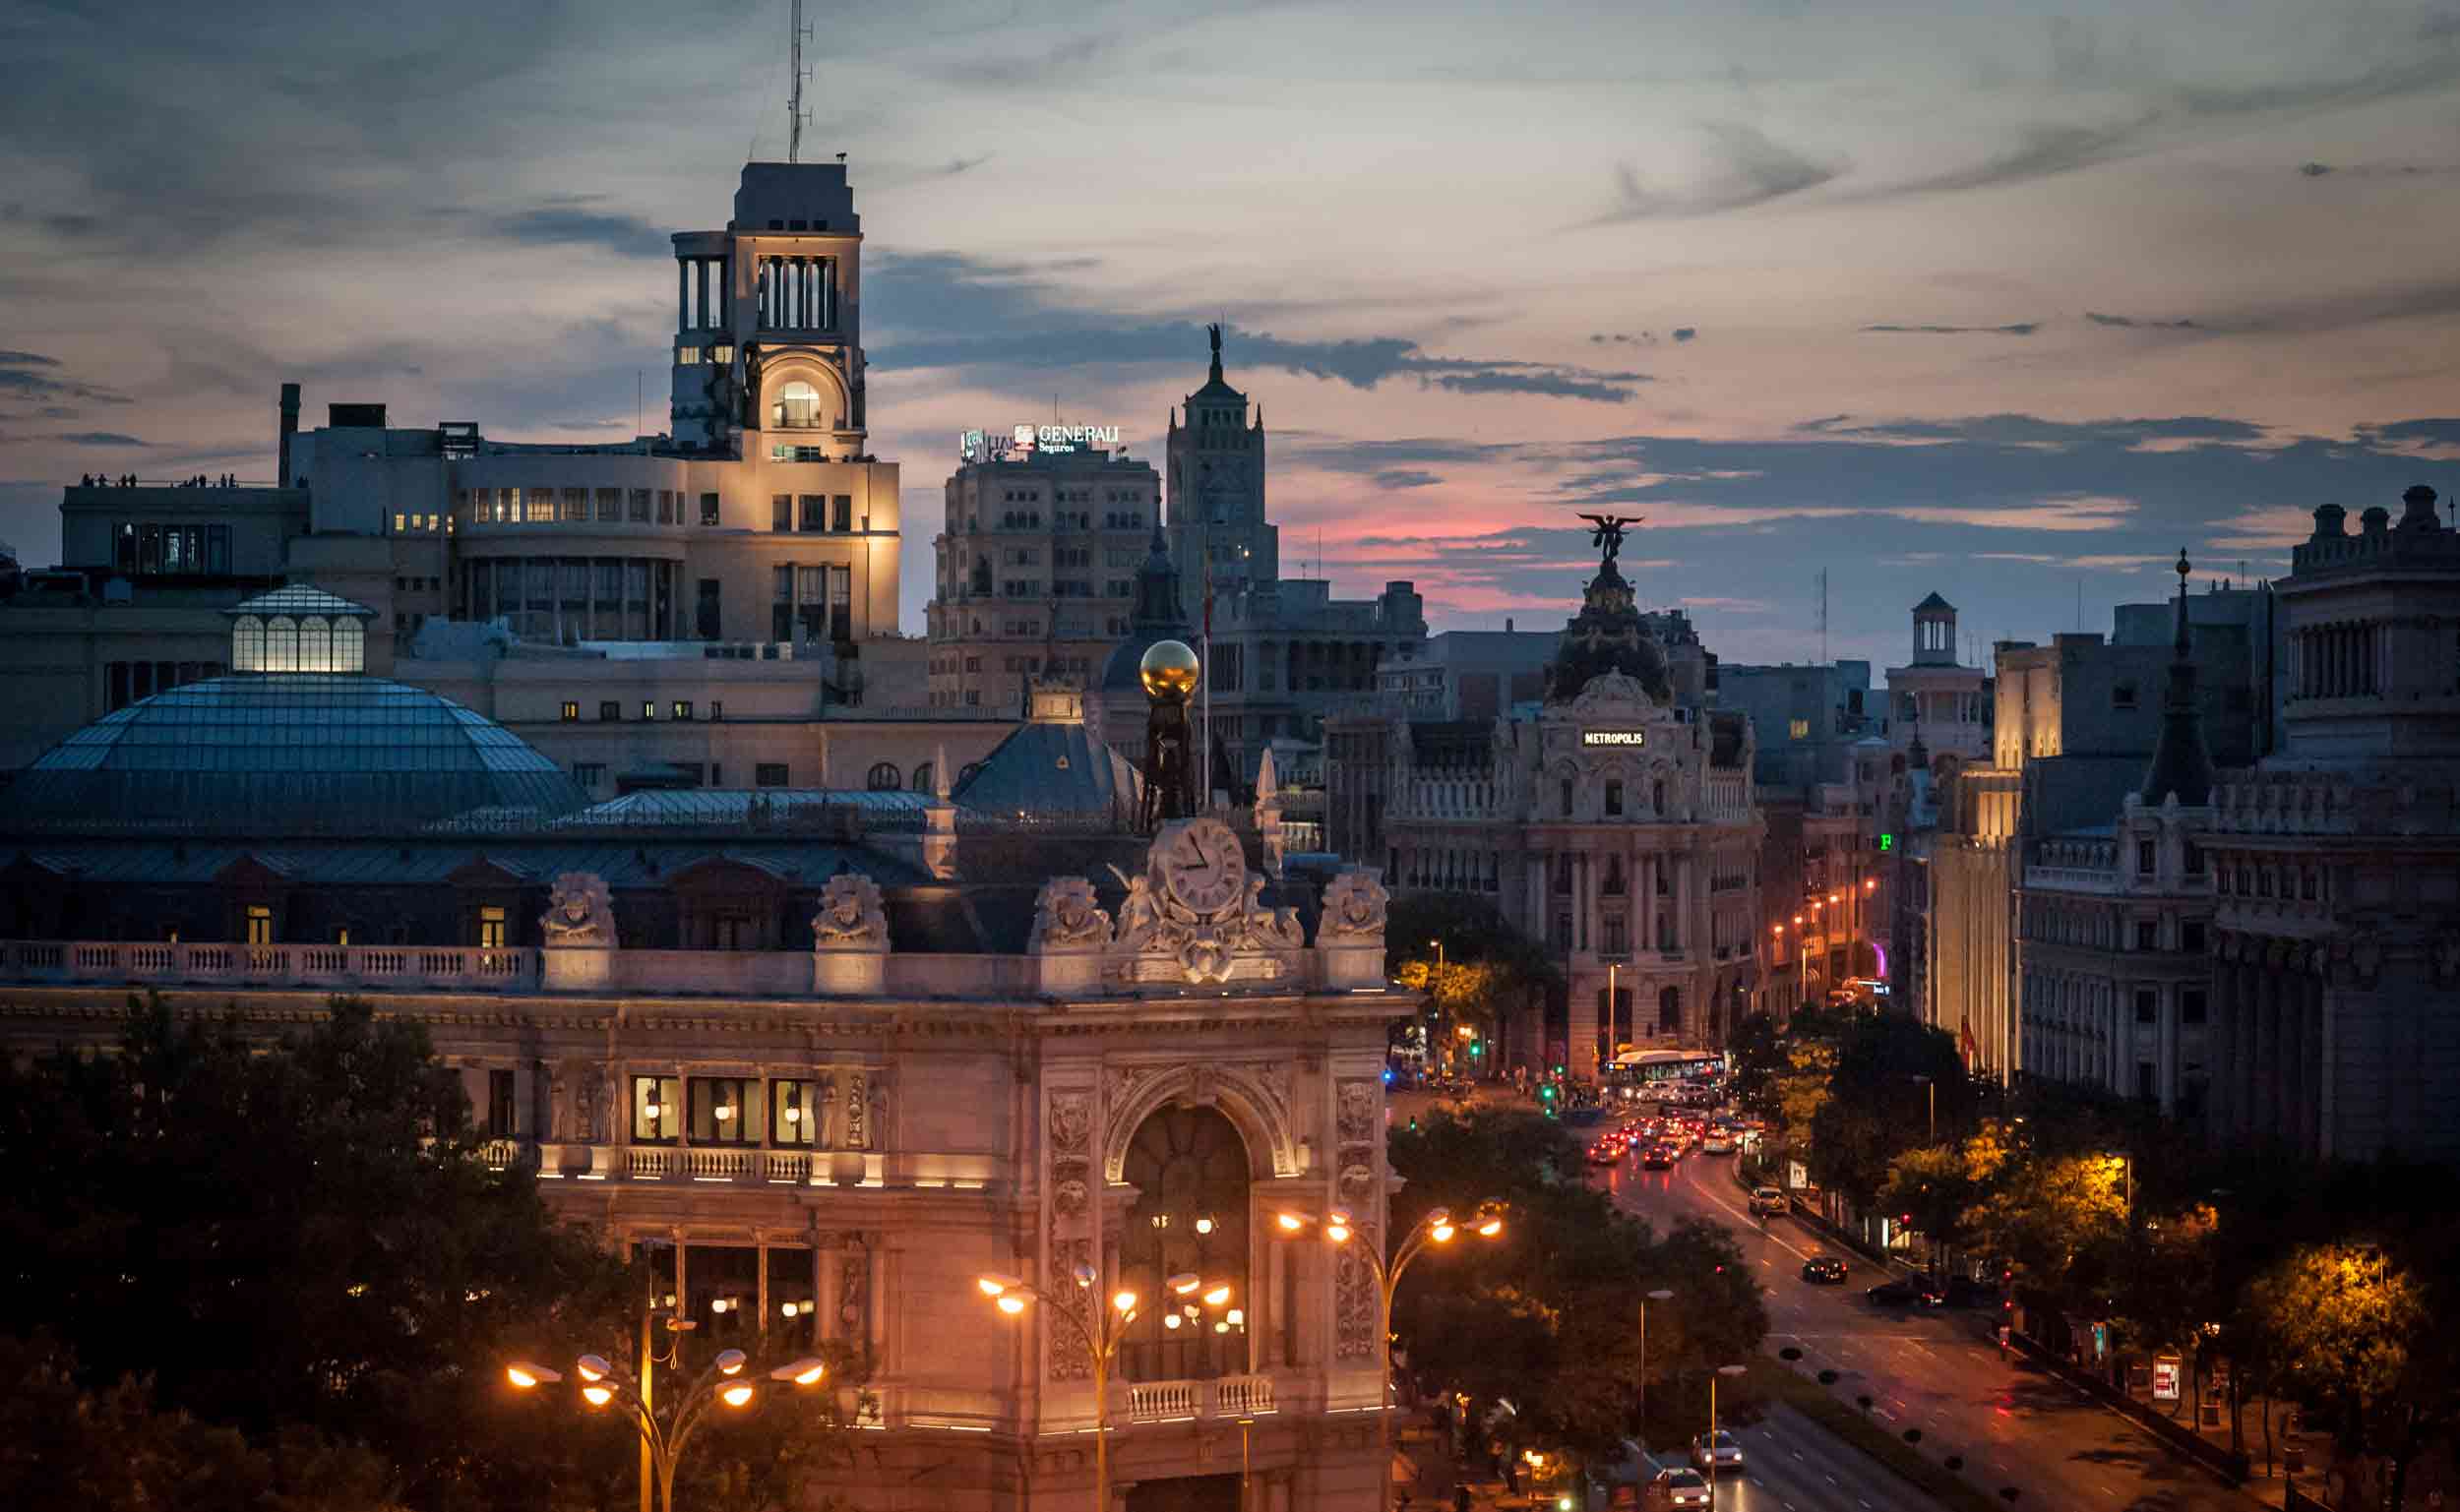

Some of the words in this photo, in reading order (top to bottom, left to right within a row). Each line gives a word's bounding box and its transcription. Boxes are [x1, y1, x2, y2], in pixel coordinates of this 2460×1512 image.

[1038, 425, 1119, 442] GENERALI
[1038, 442, 1075, 454] Seguros
[1584, 733, 1643, 745] METROPOLIS
